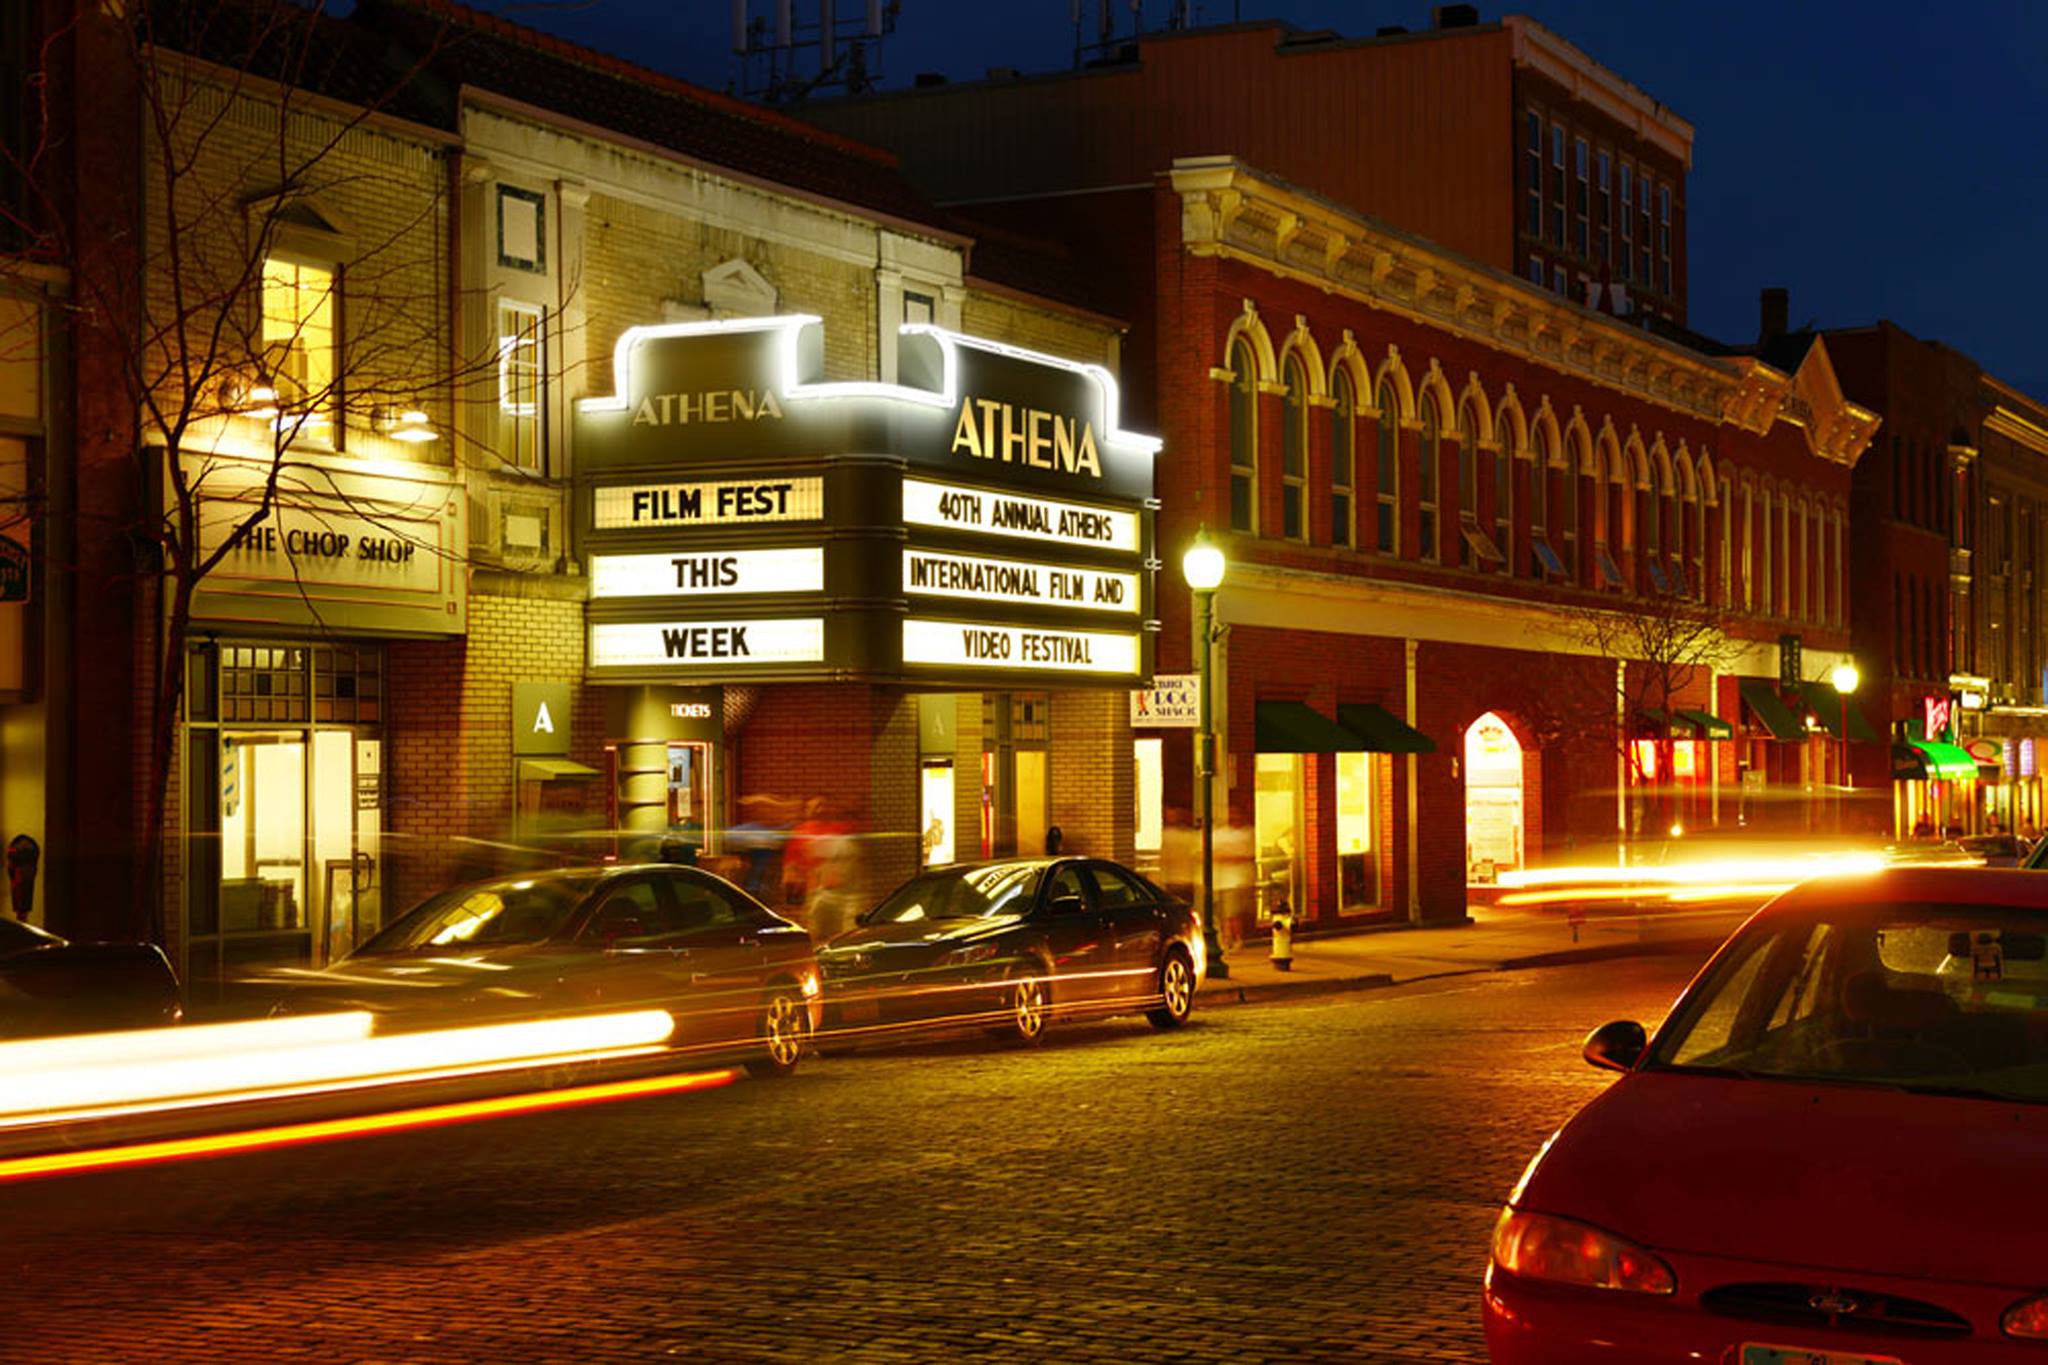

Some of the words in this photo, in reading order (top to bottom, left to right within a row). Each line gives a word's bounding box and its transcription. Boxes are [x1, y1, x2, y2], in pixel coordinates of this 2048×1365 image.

[633, 389, 783, 426] ATHENA
[952, 396, 1101, 478] ATHENA
[633, 489, 701, 521] FILM
[717, 484, 792, 517] FEST
[939, 492, 982, 524] 40TH
[991, 501, 1053, 534] ANNUAL
[1058, 509, 1113, 541] ATHENS
[287, 529, 350, 557] CHOP
[359, 536, 415, 563] SHOP
[671, 557, 739, 588] THIS
[910, 556, 1041, 597] INTERNATIONAL
[1050, 572, 1084, 601] FILM
[1094, 577, 1124, 604] AND
[662, 626, 751, 658] WEEK
[963, 630, 1011, 660] VIDEO
[1021, 634, 1093, 664] FESTIVAL
[533, 701, 554, 733] A
[670, 703, 712, 718] TICKETS
